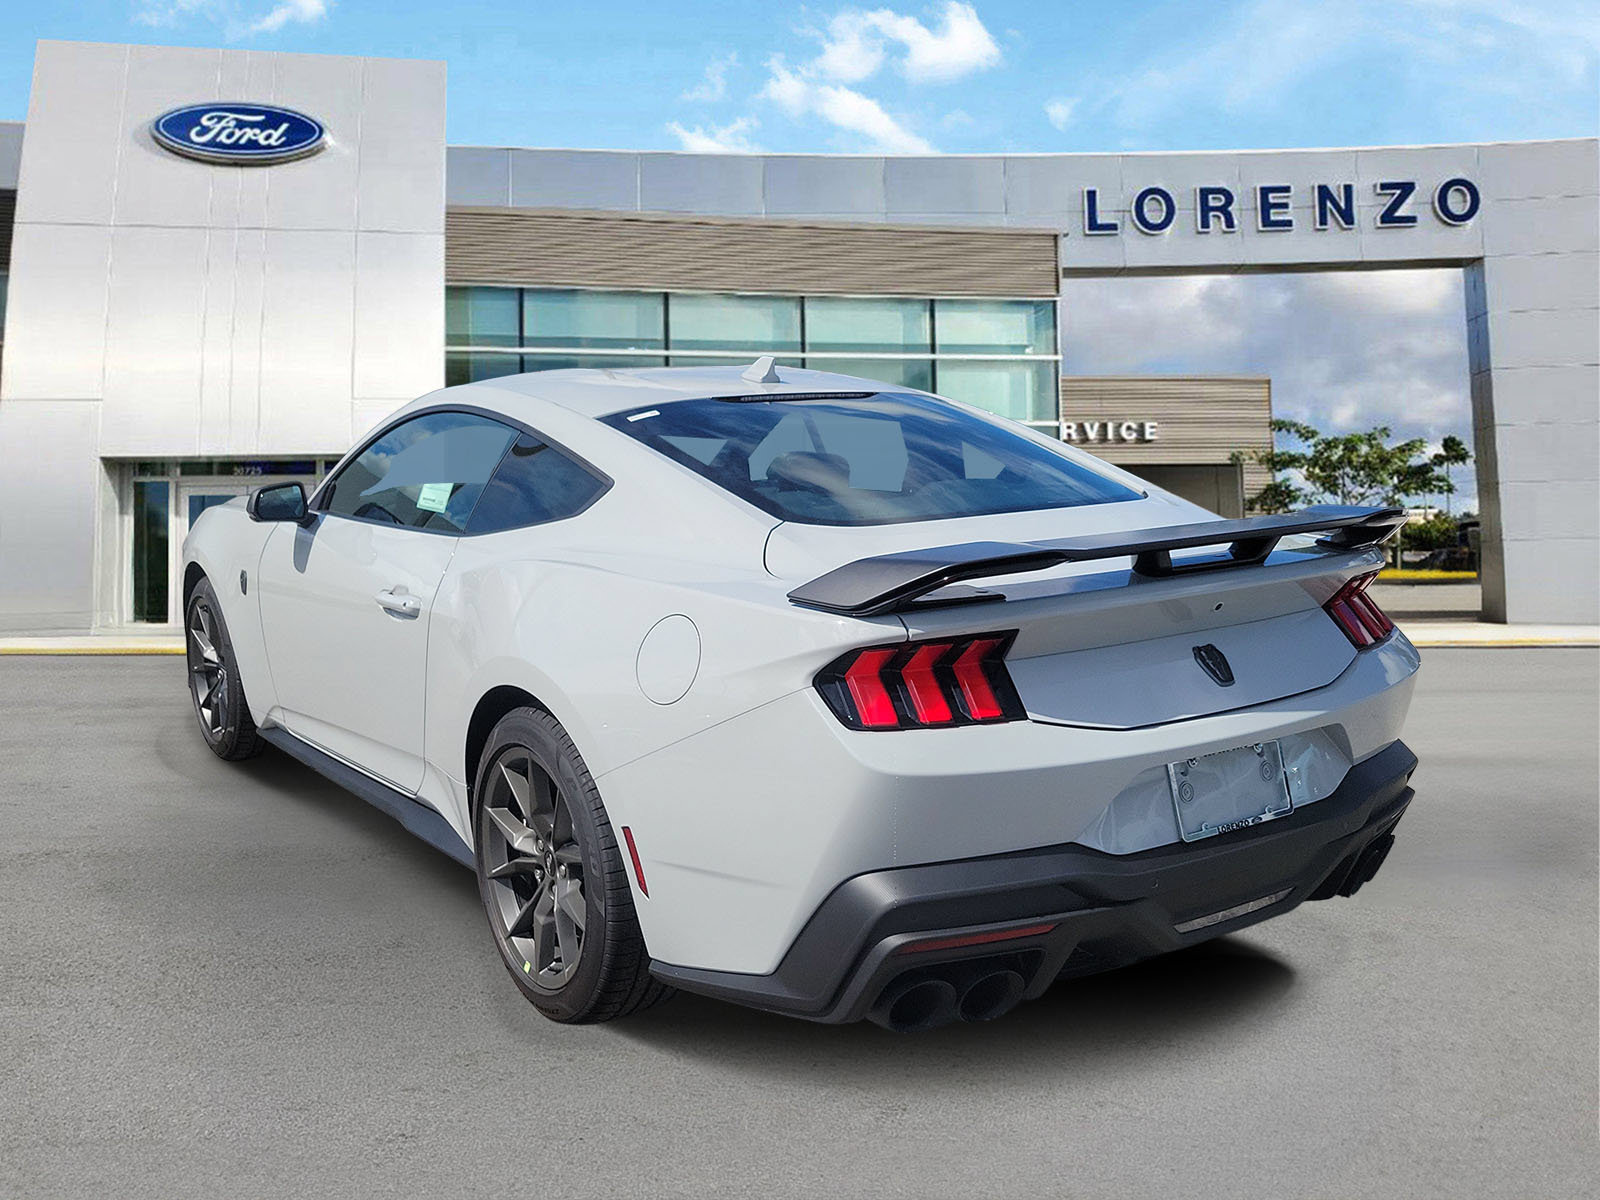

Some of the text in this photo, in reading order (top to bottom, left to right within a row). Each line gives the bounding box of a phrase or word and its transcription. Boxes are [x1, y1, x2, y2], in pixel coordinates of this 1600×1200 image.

[190, 111, 290, 146] Ford
[1083, 177, 1481, 235] LORENZO
[1216, 818, 1251, 835] LORENZO
